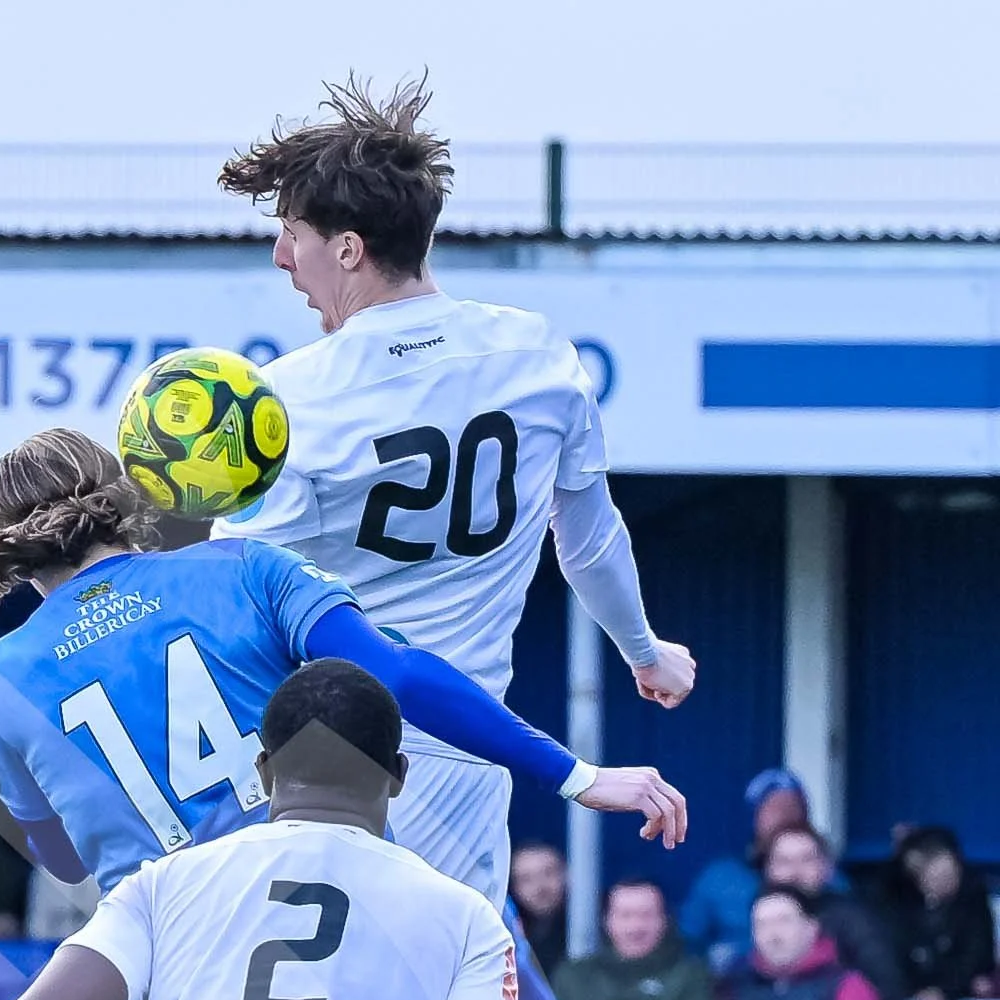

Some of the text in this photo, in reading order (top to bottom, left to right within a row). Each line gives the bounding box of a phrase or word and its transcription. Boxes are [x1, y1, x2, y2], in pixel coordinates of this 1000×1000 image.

[356, 410, 518, 562] 20
[53, 597, 162, 660] BILLERICAY
[64, 591, 142, 637] CROWN
[76, 590, 120, 616] THE
[60, 632, 270, 853] 14
